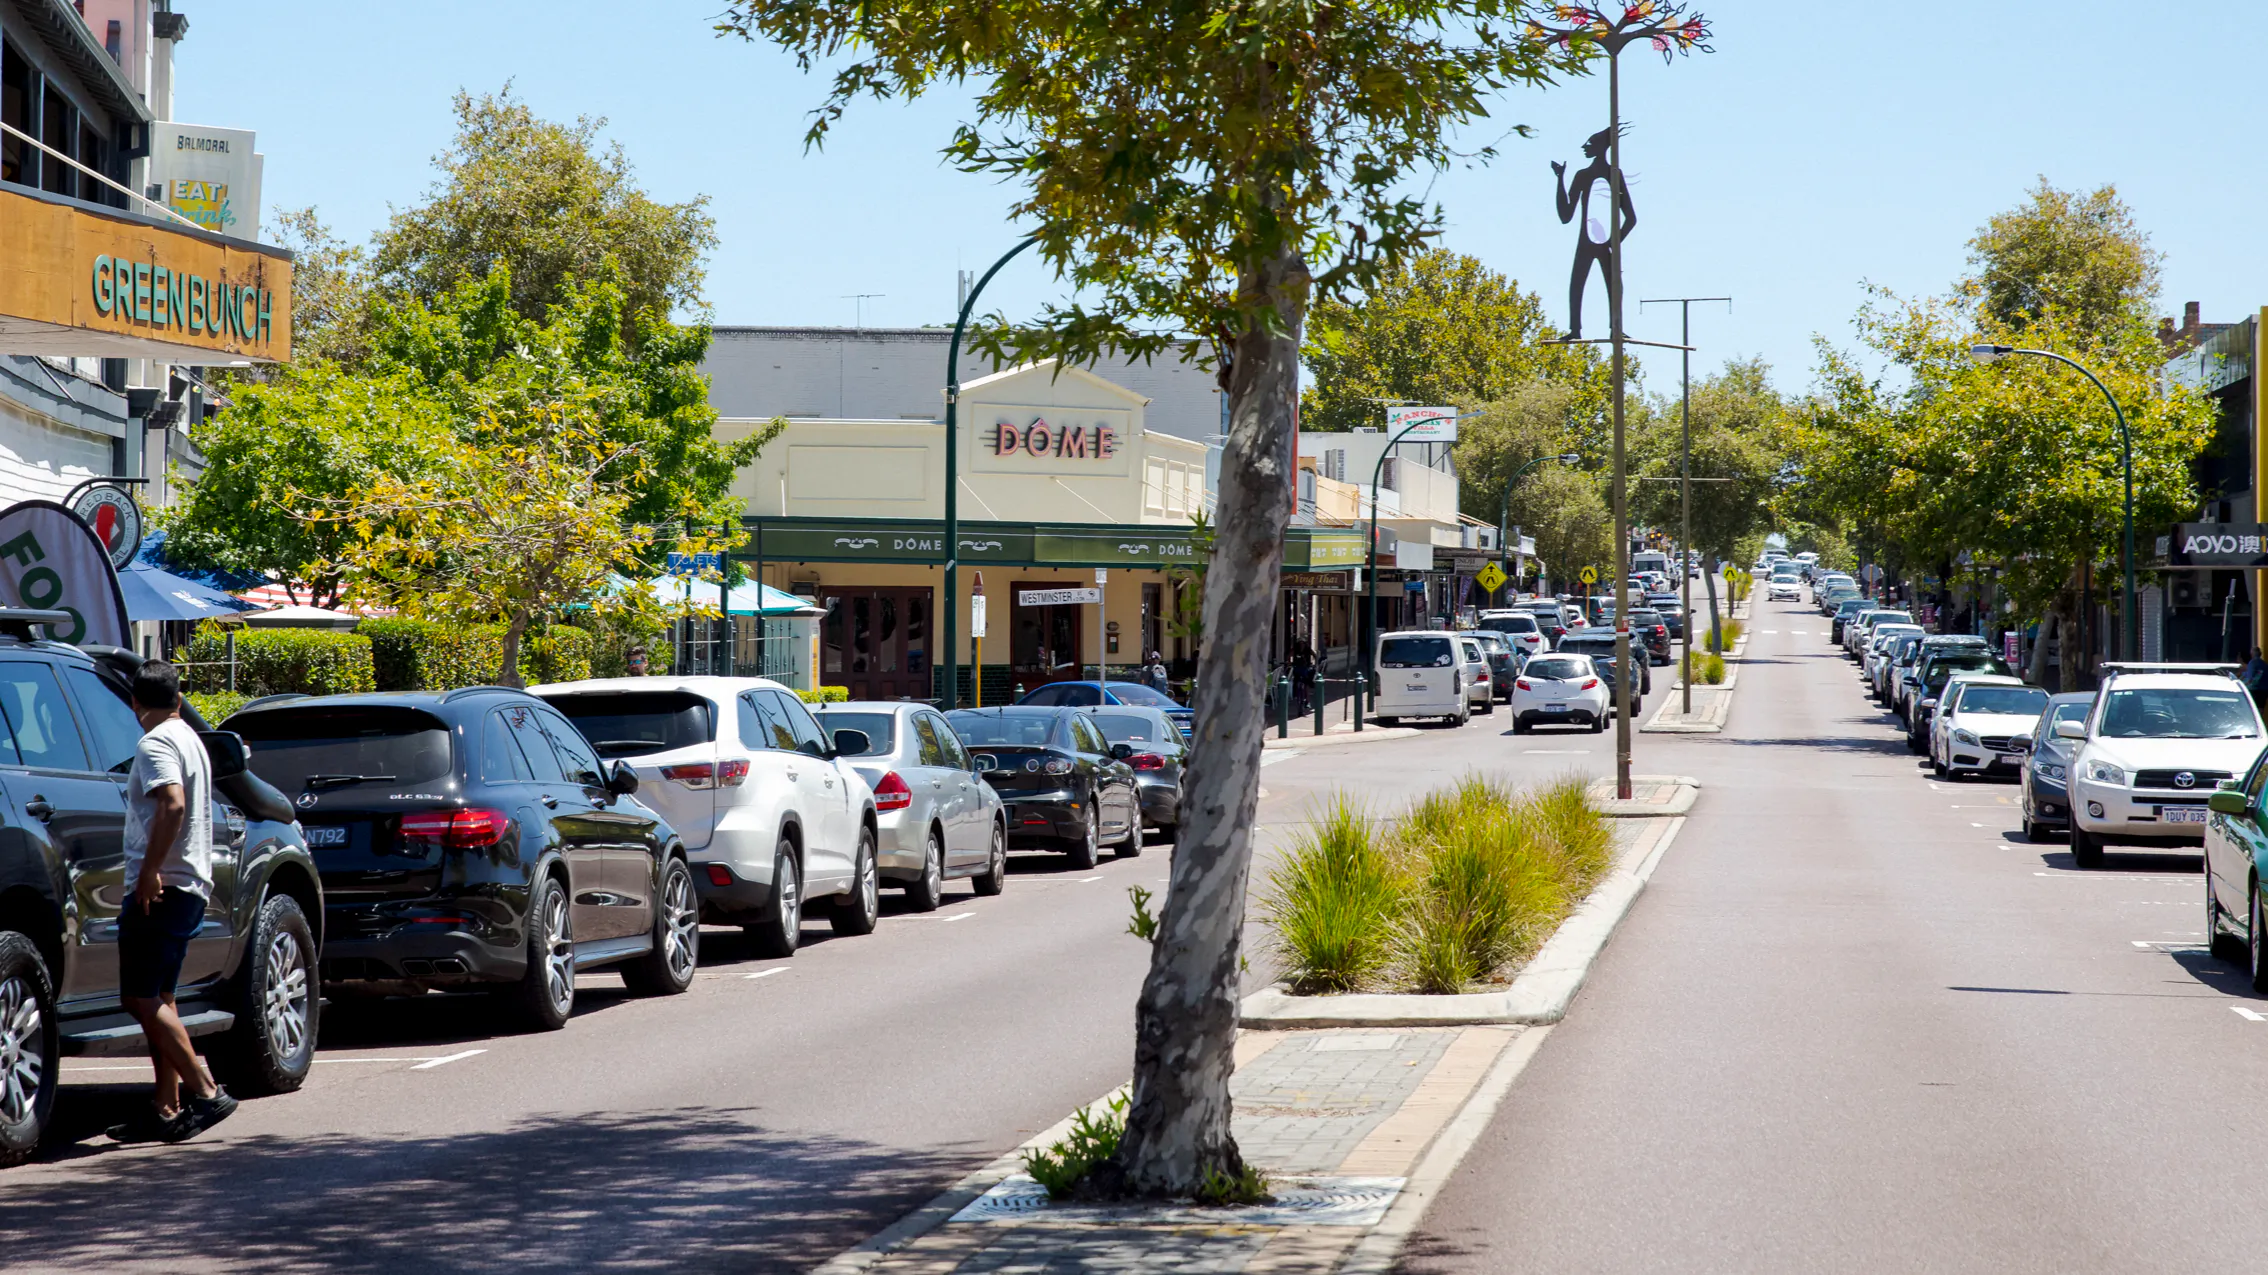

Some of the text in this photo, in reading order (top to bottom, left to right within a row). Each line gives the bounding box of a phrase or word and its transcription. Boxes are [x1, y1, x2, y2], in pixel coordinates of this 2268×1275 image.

[177, 135, 230, 153] BALMORAL
[995, 417, 1114, 459] DÔME
[80, 492, 134, 520] REDBACK
[0, 529, 98, 646] FOO
[1021, 591, 1073, 604] WESTMINSTER
[2191, 812, 2206, 822] 035
[306, 828, 346, 844] N792
